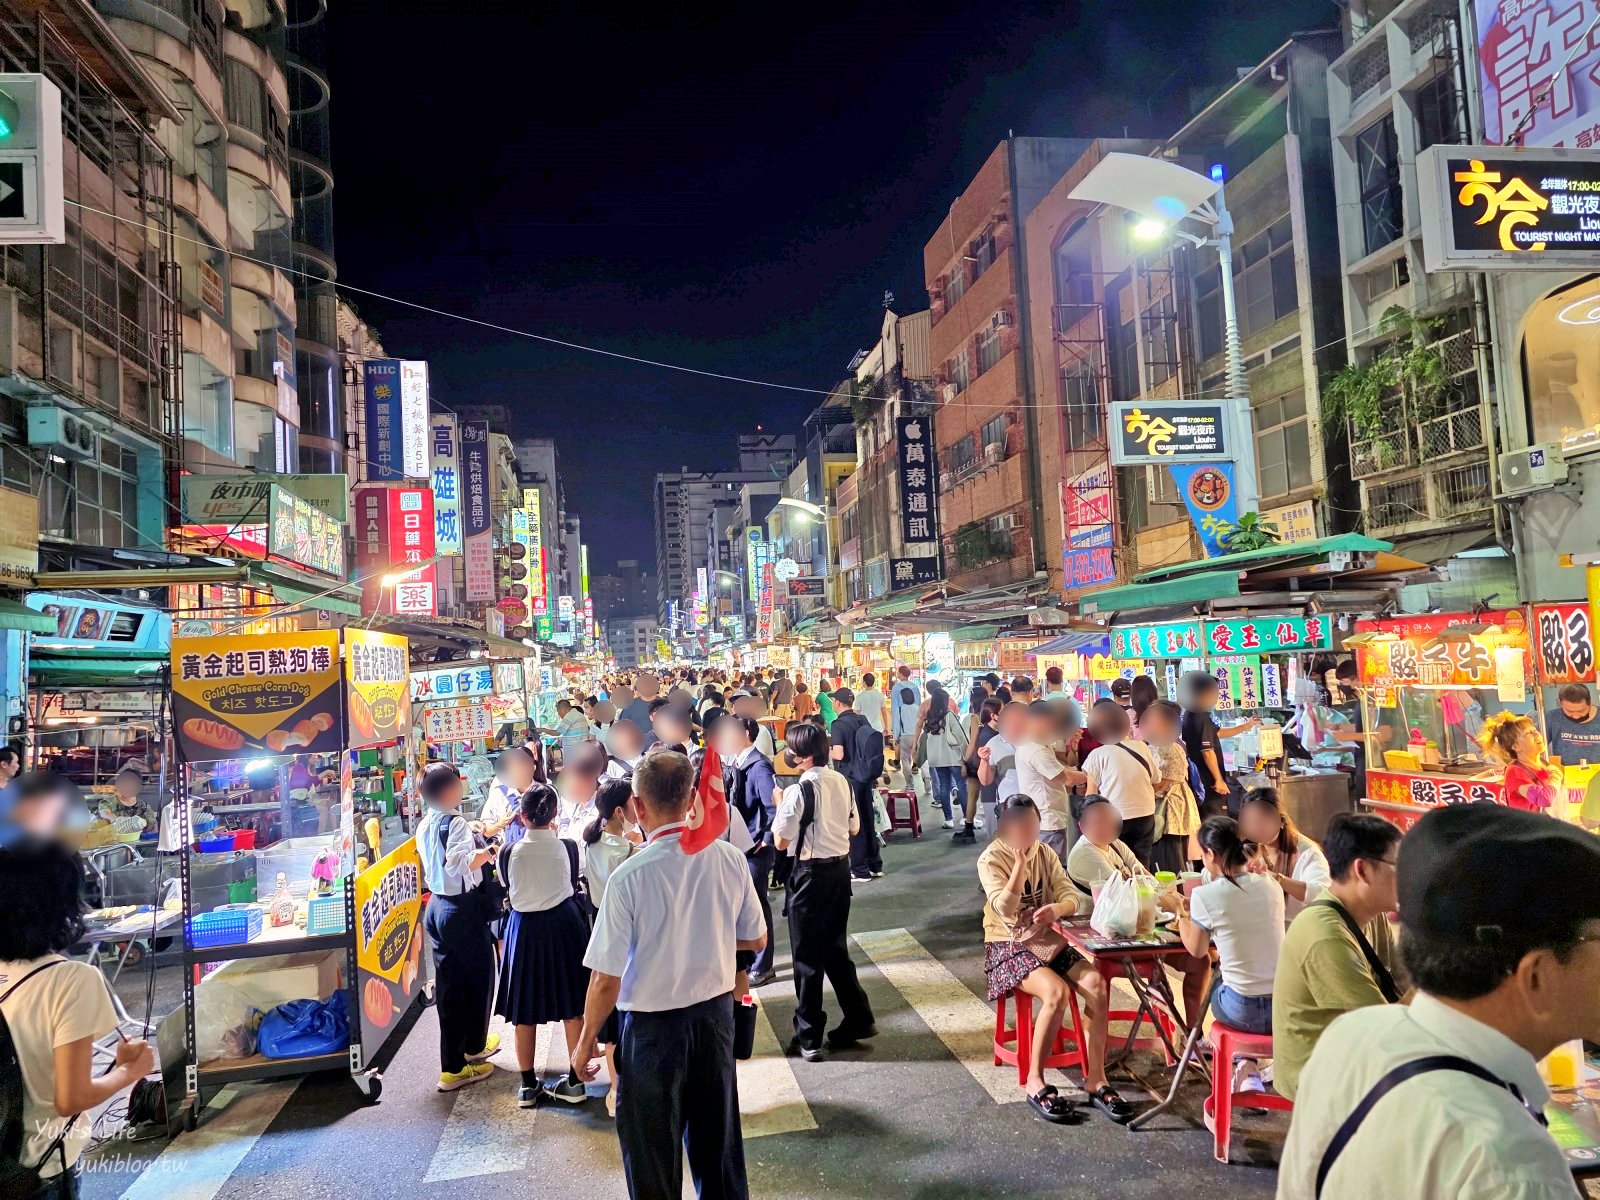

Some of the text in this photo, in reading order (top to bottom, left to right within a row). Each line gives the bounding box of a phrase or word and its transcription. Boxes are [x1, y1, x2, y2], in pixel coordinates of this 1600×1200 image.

[1514, 232, 1552, 241] TOURIST
[1555, 232, 1581, 241] NIGHT
[368, 366, 396, 374] HIIC
[377, 403, 392, 477] 國際新創中心
[432, 424, 458, 543] 高雄城
[904, 443, 930, 538] 萬泰通訊
[1541, 612, 1592, 676] 骰子
[182, 648, 330, 679] 黃金起司熱狗棒
[203, 681, 311, 701] Gold Cheese Corn Dog
[1217, 667, 1231, 701] 粉圓冰
[1242, 667, 1255, 700] 仙草冰
[1265, 664, 1278, 698] 愛玉冰
[221, 699, 247, 710] 치즈
[1220, 701, 1231, 709] 30
[1245, 700, 1256, 708] 30
